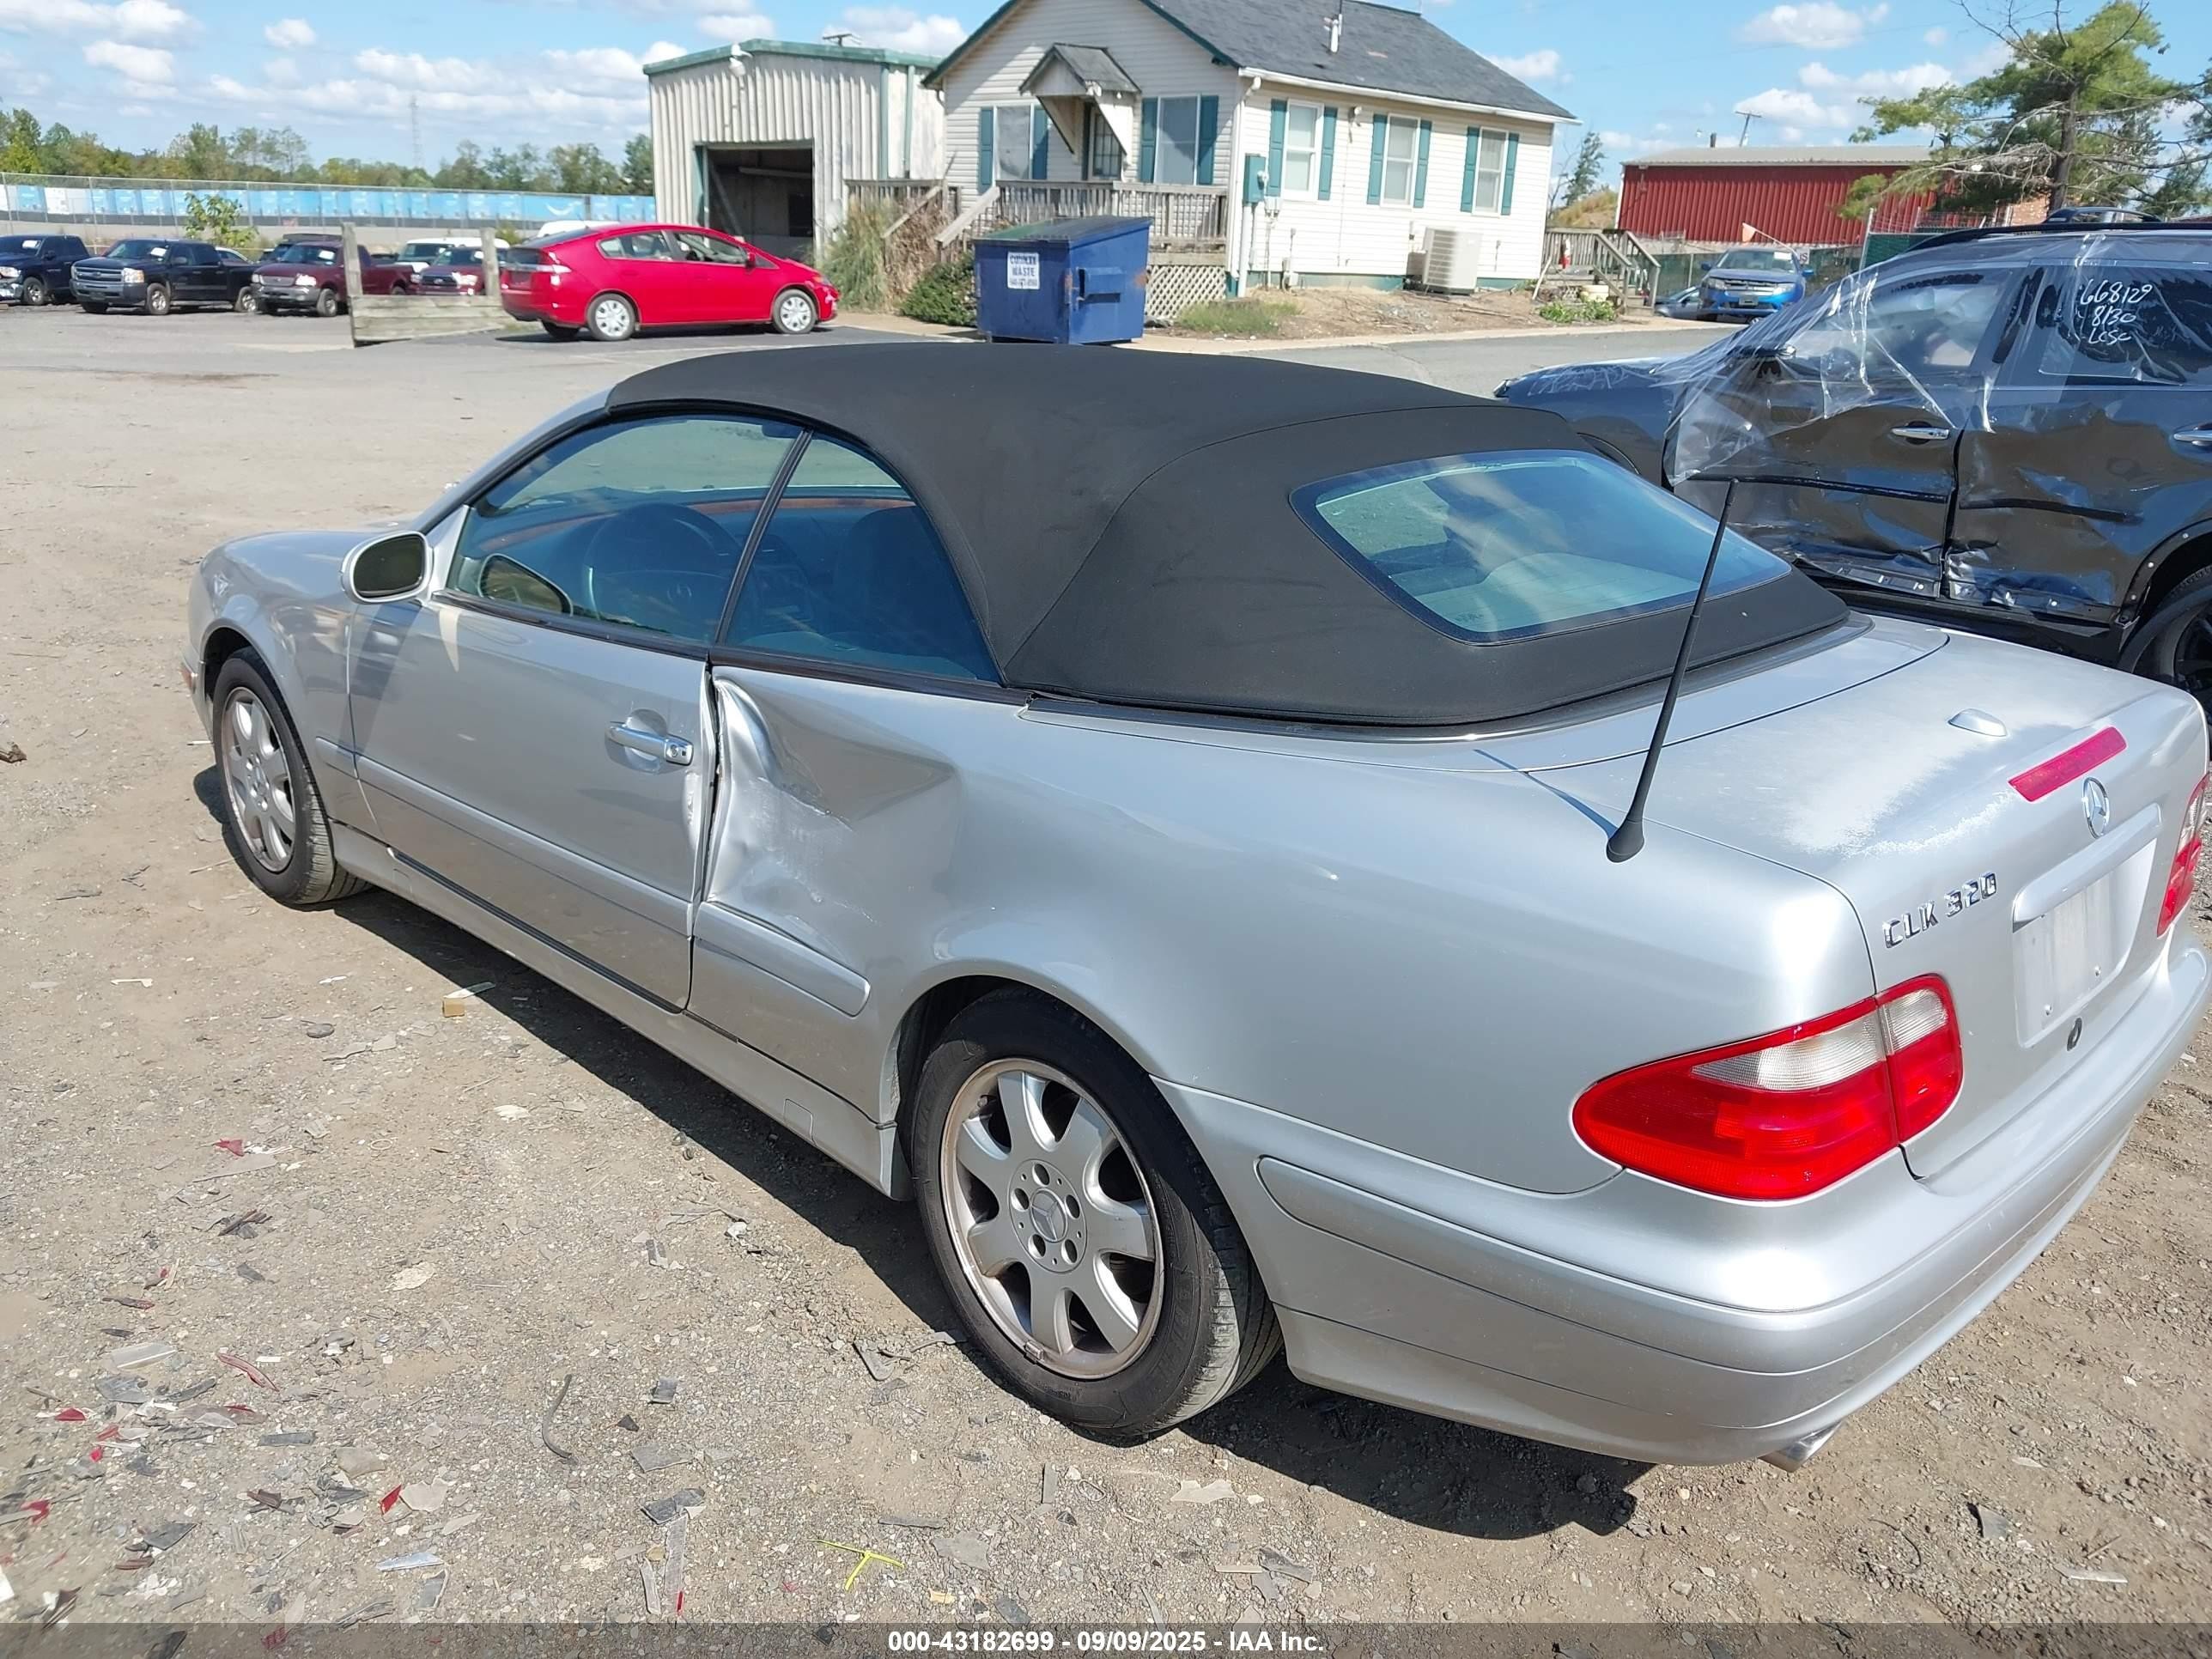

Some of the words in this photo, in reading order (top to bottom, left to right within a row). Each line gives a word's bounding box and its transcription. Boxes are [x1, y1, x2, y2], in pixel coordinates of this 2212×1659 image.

[1012, 267, 1036, 276] WASTE
[2080, 278, 2154, 305] 668129
[1882, 902, 1938, 949] CLK
[1945, 872, 1997, 917] 320
